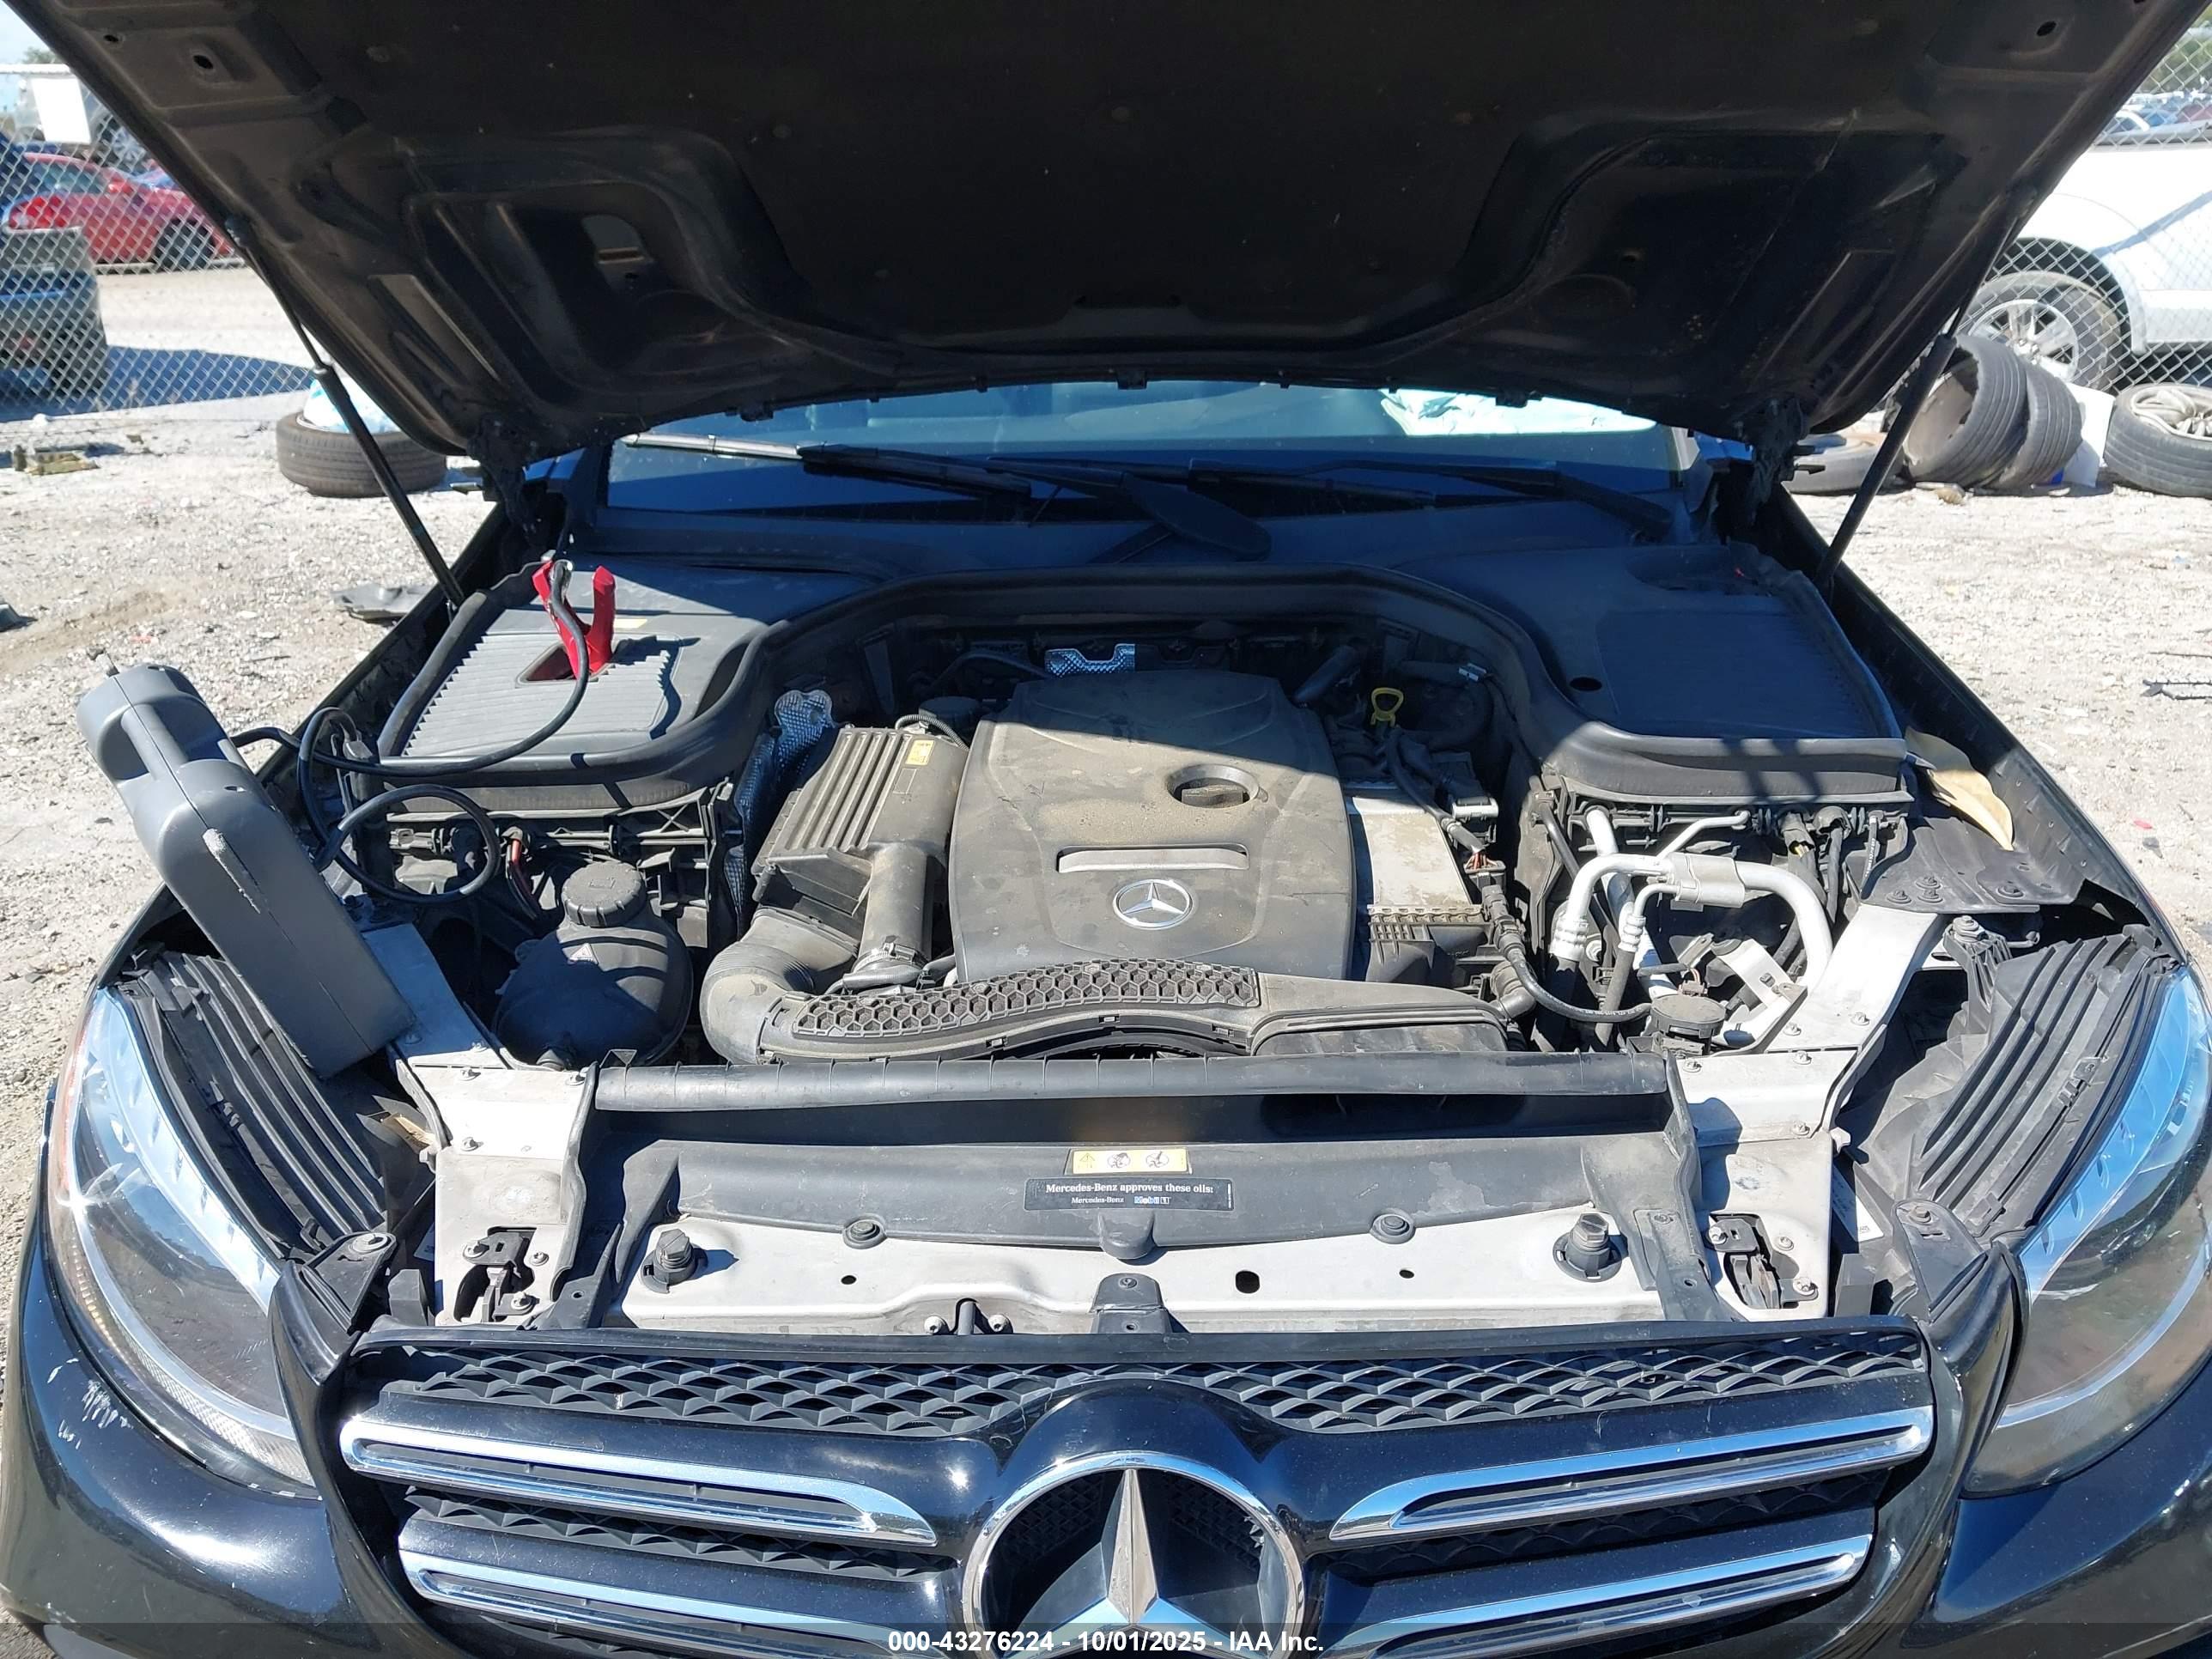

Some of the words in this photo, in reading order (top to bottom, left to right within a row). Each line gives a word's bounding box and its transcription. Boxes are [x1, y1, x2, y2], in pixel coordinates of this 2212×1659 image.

[1046, 1183, 1118, 1193] Mercedes-Benz
[1120, 1183, 1162, 1194] approves
[1165, 1183, 1191, 1193] these
[1193, 1183, 1214, 1193] oils:
